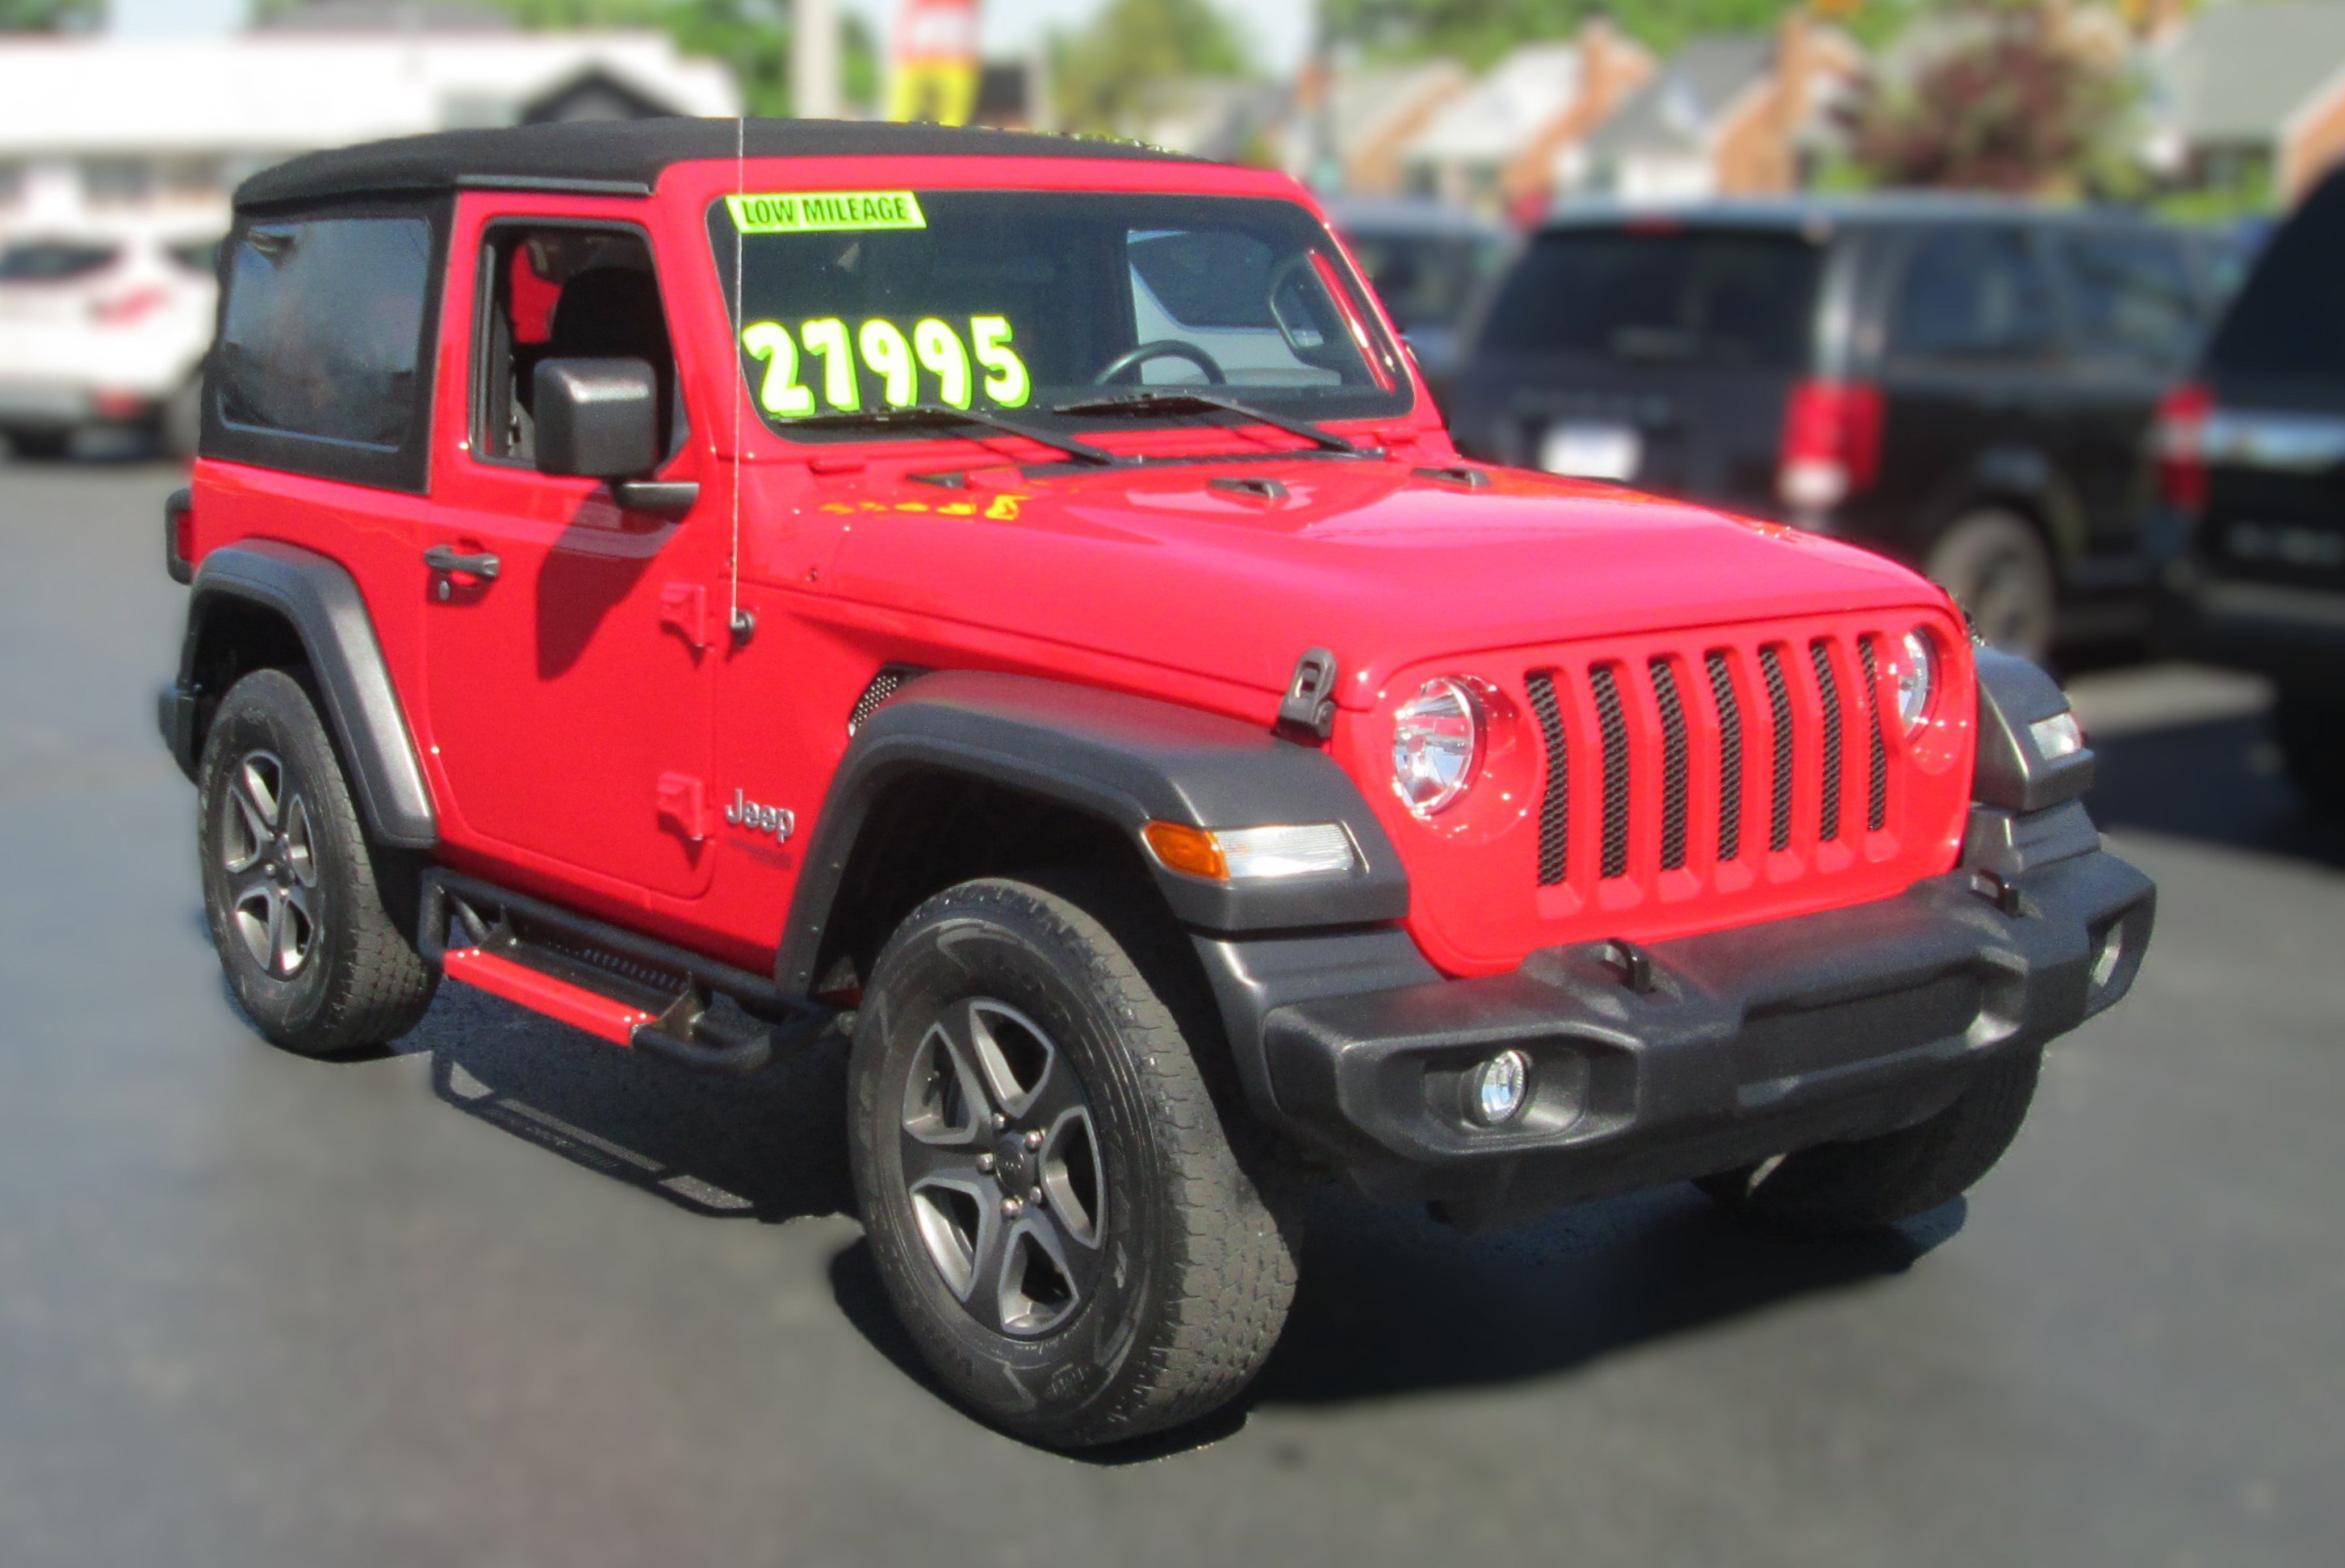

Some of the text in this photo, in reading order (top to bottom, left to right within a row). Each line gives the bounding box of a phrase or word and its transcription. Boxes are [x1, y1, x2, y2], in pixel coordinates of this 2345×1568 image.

[742, 196, 909, 224] LOW MILEAGE
[741, 315, 1031, 416] 27995
[725, 788, 795, 843] Jeep
